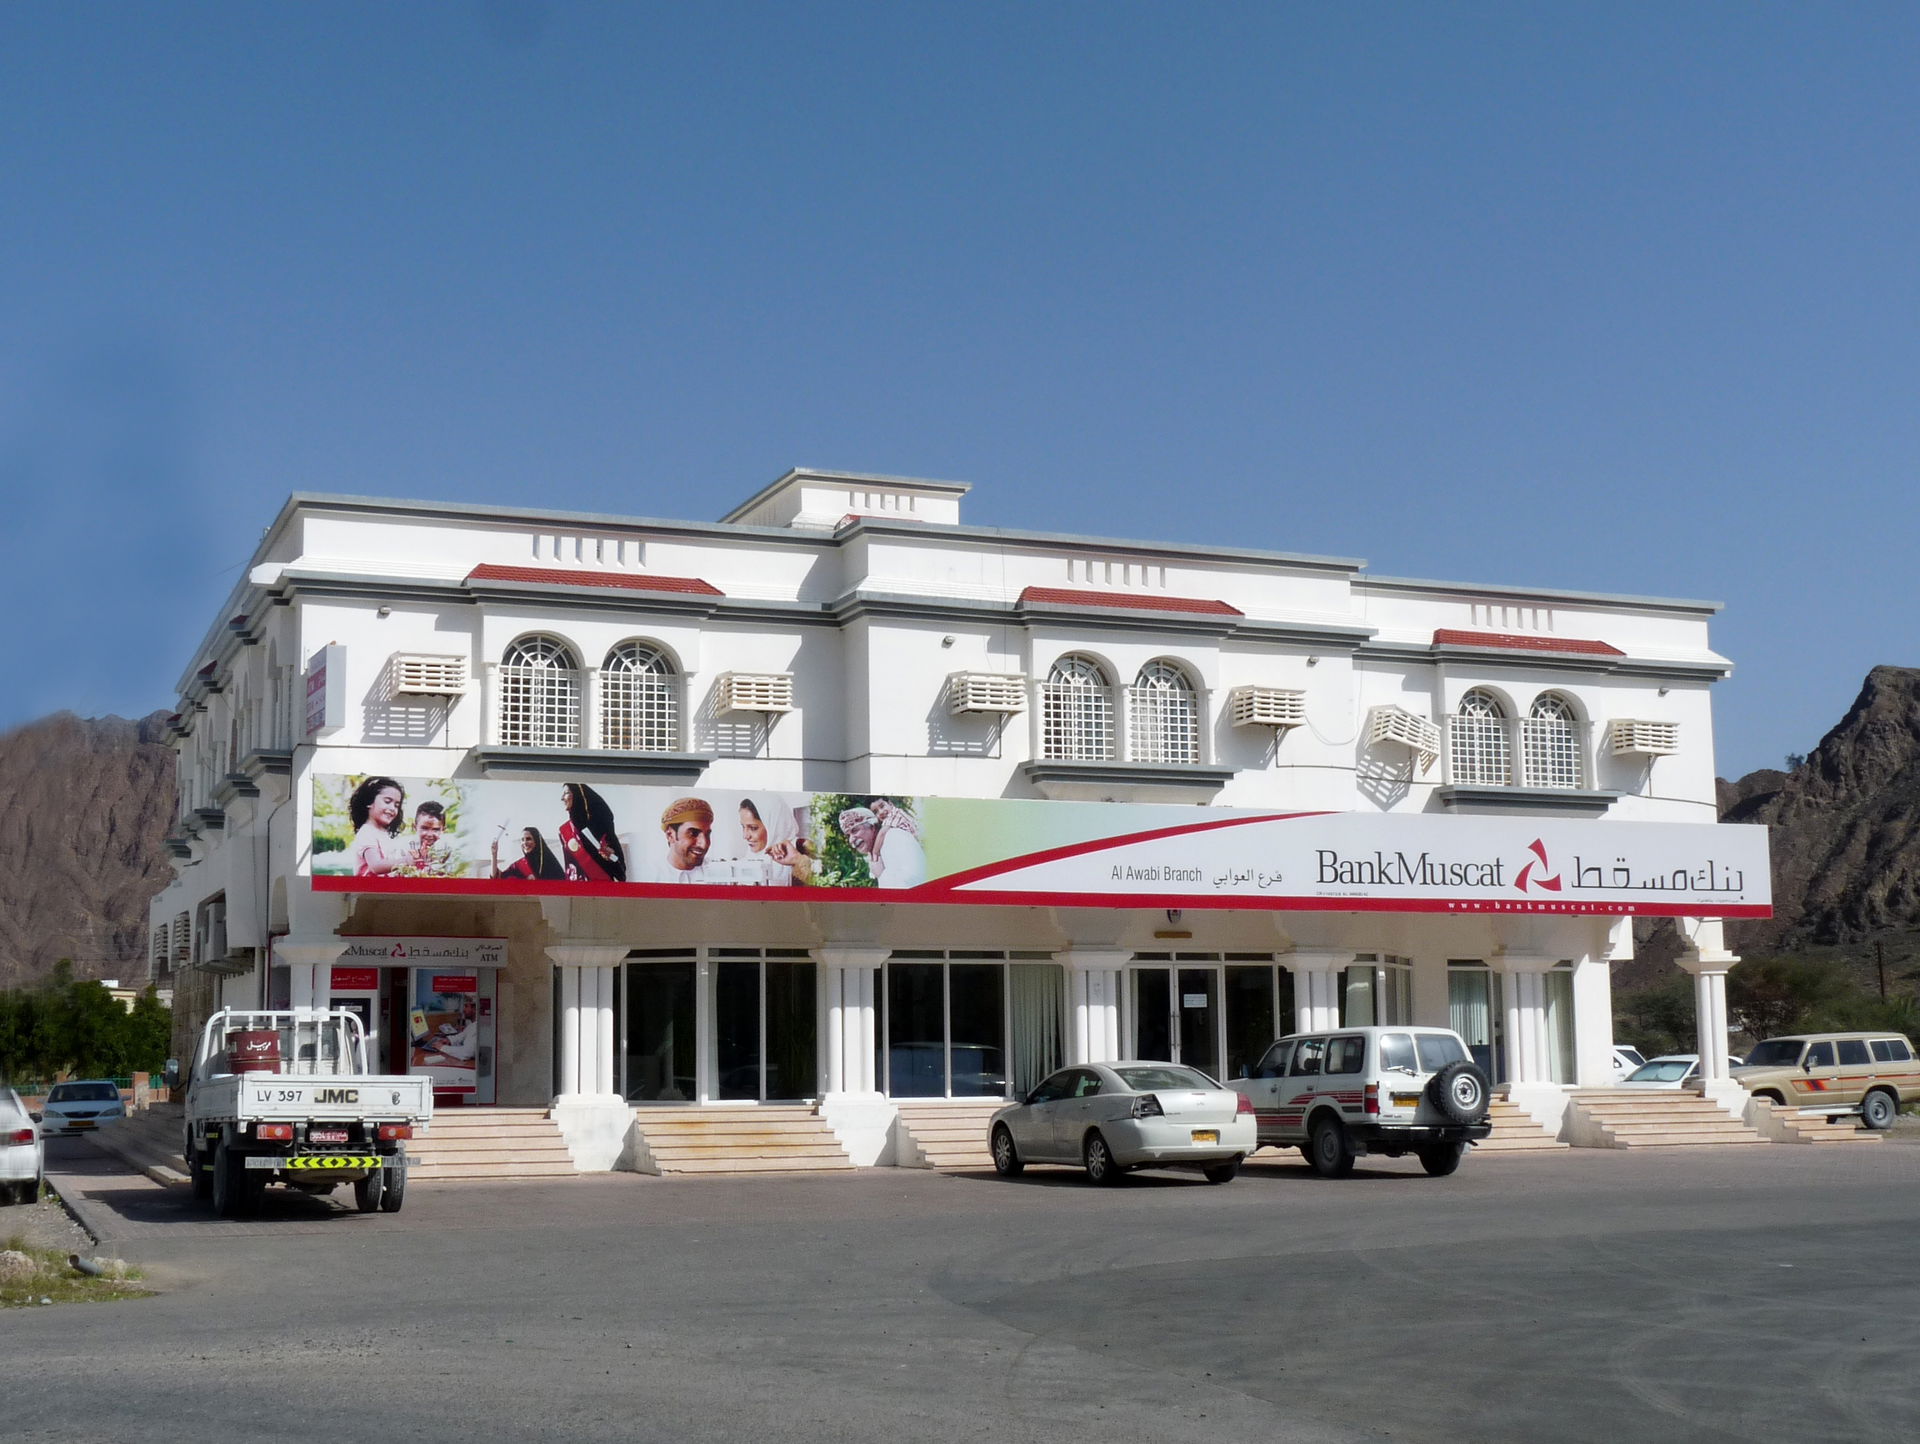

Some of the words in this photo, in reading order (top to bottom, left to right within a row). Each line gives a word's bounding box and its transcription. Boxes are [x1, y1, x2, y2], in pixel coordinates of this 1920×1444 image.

[1111, 865, 1123, 881] Al
[1125, 865, 1160, 881] Awabi
[1163, 866, 1202, 882] Branch
[1315, 849, 1506, 887] BankMuscat
[1212, 868, 1254, 889] العوابي
[1257, 870, 1283, 889] فرع
[1448, 901, 1636, 913] www.bankmuscat.com
[480, 953, 498, 962] ATM
[278, 1090, 303, 1102] 397
[314, 1089, 359, 1104] JMC
